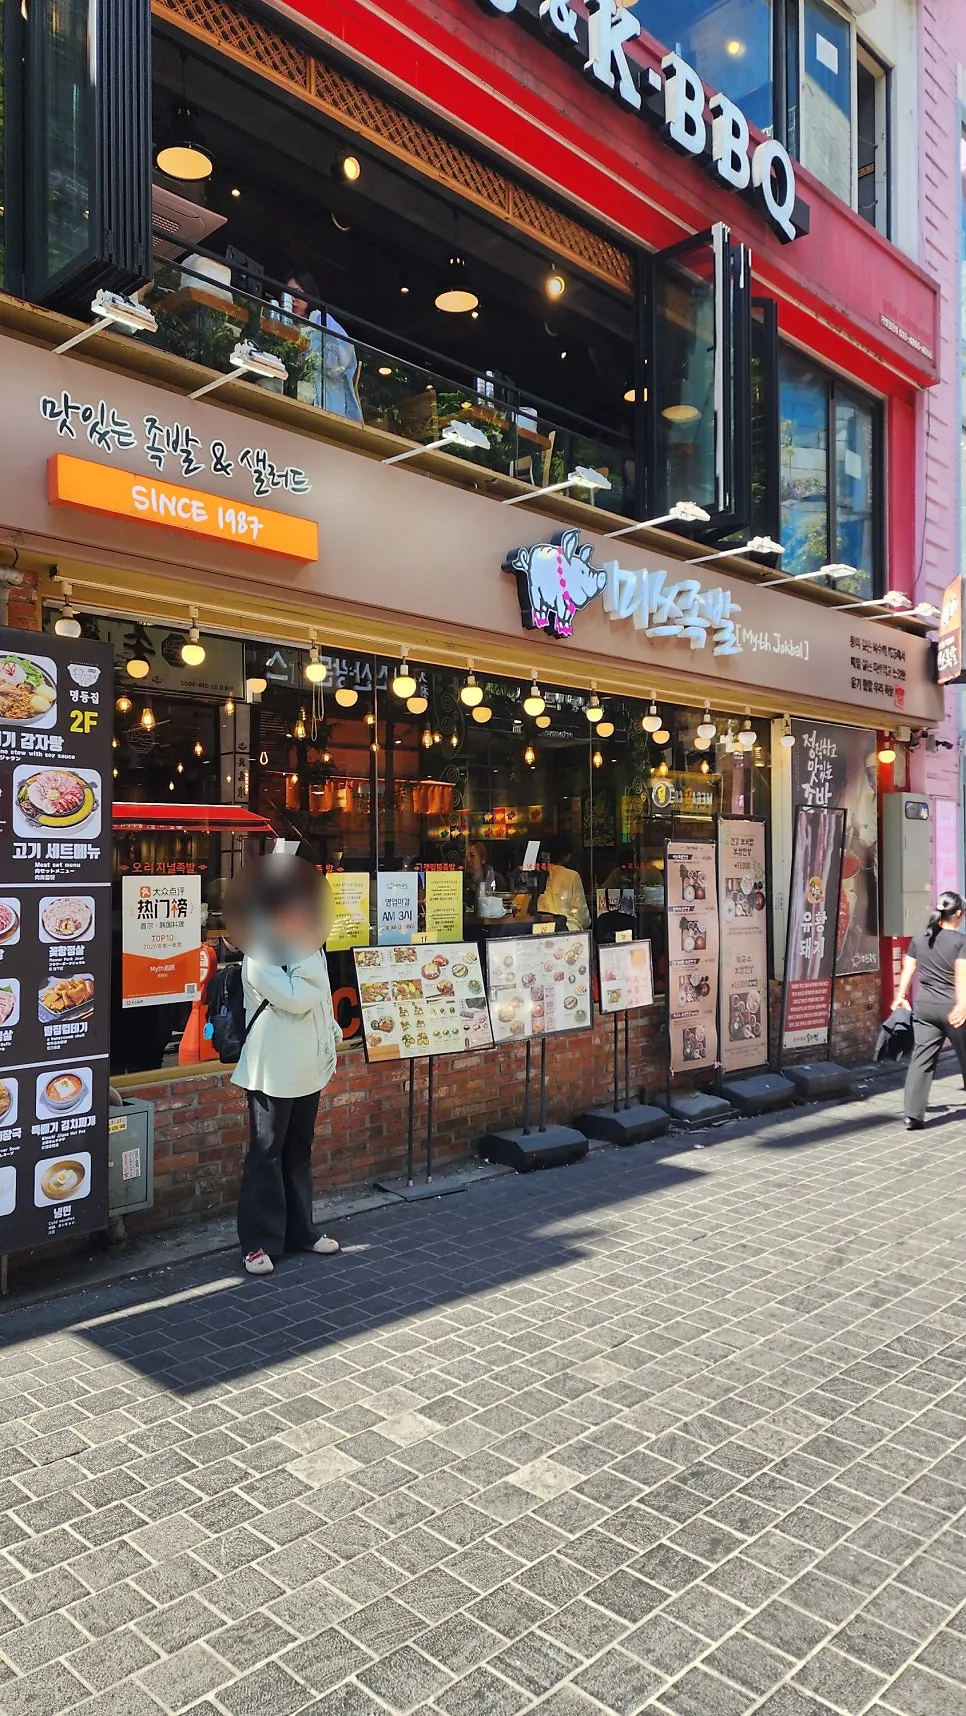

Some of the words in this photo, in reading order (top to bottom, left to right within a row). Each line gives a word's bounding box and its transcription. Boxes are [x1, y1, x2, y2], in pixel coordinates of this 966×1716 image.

[40, 390, 137, 453] 맛있는
[143, 414, 205, 478] 족발
[210, 439, 234, 478] &
[239, 447, 312, 497] 샐러드
[131, 485, 208, 523] SINCE
[217, 506, 263, 540] 1987
[70, 709, 99, 734] 2F
[0, 730, 16, 749] 기
[21, 732, 65, 752] 감자탕
[12, 842, 42, 859] 고기
[45, 843, 101, 859] 세트메뉴
[132, 862, 196, 874] 오리지널족발
[153, 887, 184, 896] 大众点评
[137, 898, 187, 919] 热门榜
[382, 911, 396, 921] AM
[398, 910, 412, 921] 3시
[801, 911, 828, 933] 유황
[799, 936, 825, 960] 돼지
[0, 1127, 22, 1142] 장국
[54, 1204, 71, 1219] 냉면
